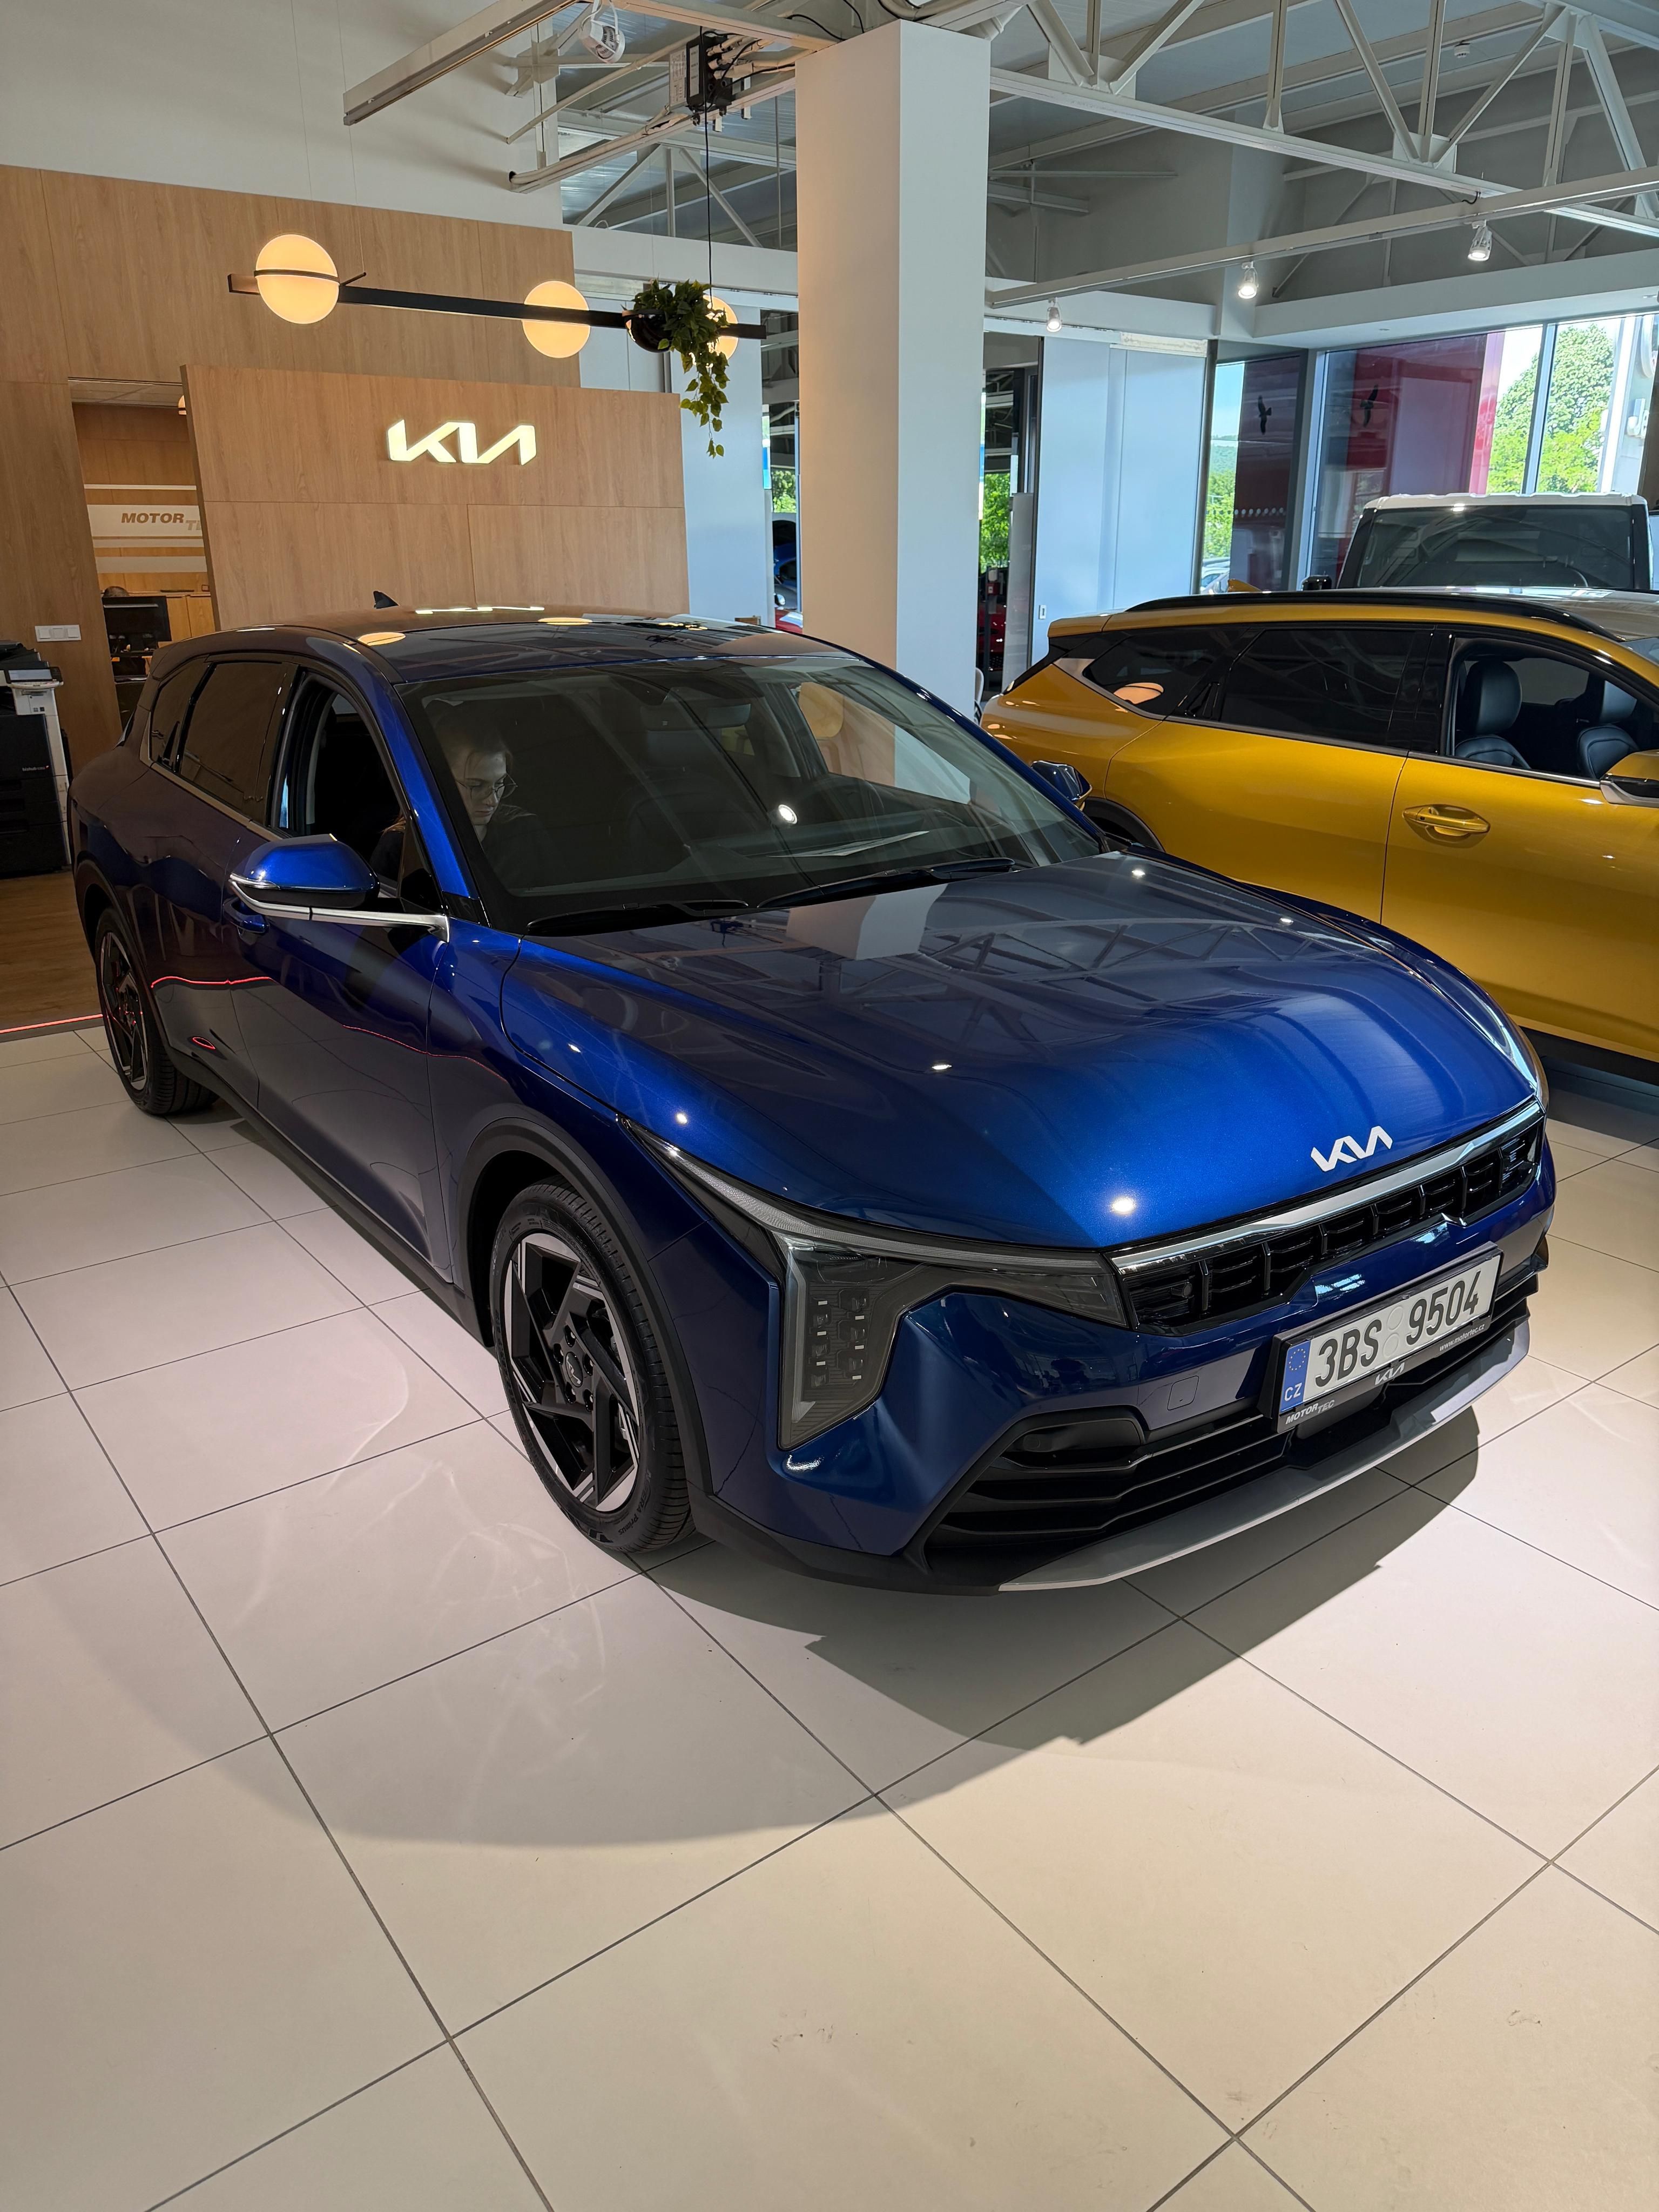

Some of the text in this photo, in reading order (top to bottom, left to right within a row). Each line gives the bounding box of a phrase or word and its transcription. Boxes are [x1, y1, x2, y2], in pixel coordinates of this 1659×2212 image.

[387, 419, 537, 466] KIA
[121, 512, 185, 523] MOTOR
[1311, 1125, 1393, 1172] KIA
[1315, 1270, 1481, 1387] 3BS 9504
[1439, 1324, 1485, 1351] www.motortec.cz
[1284, 1382, 1302, 1402] CZ
[1285, 1402, 1319, 1425] MOTOR
[618, 1513, 639, 1535] Primus
